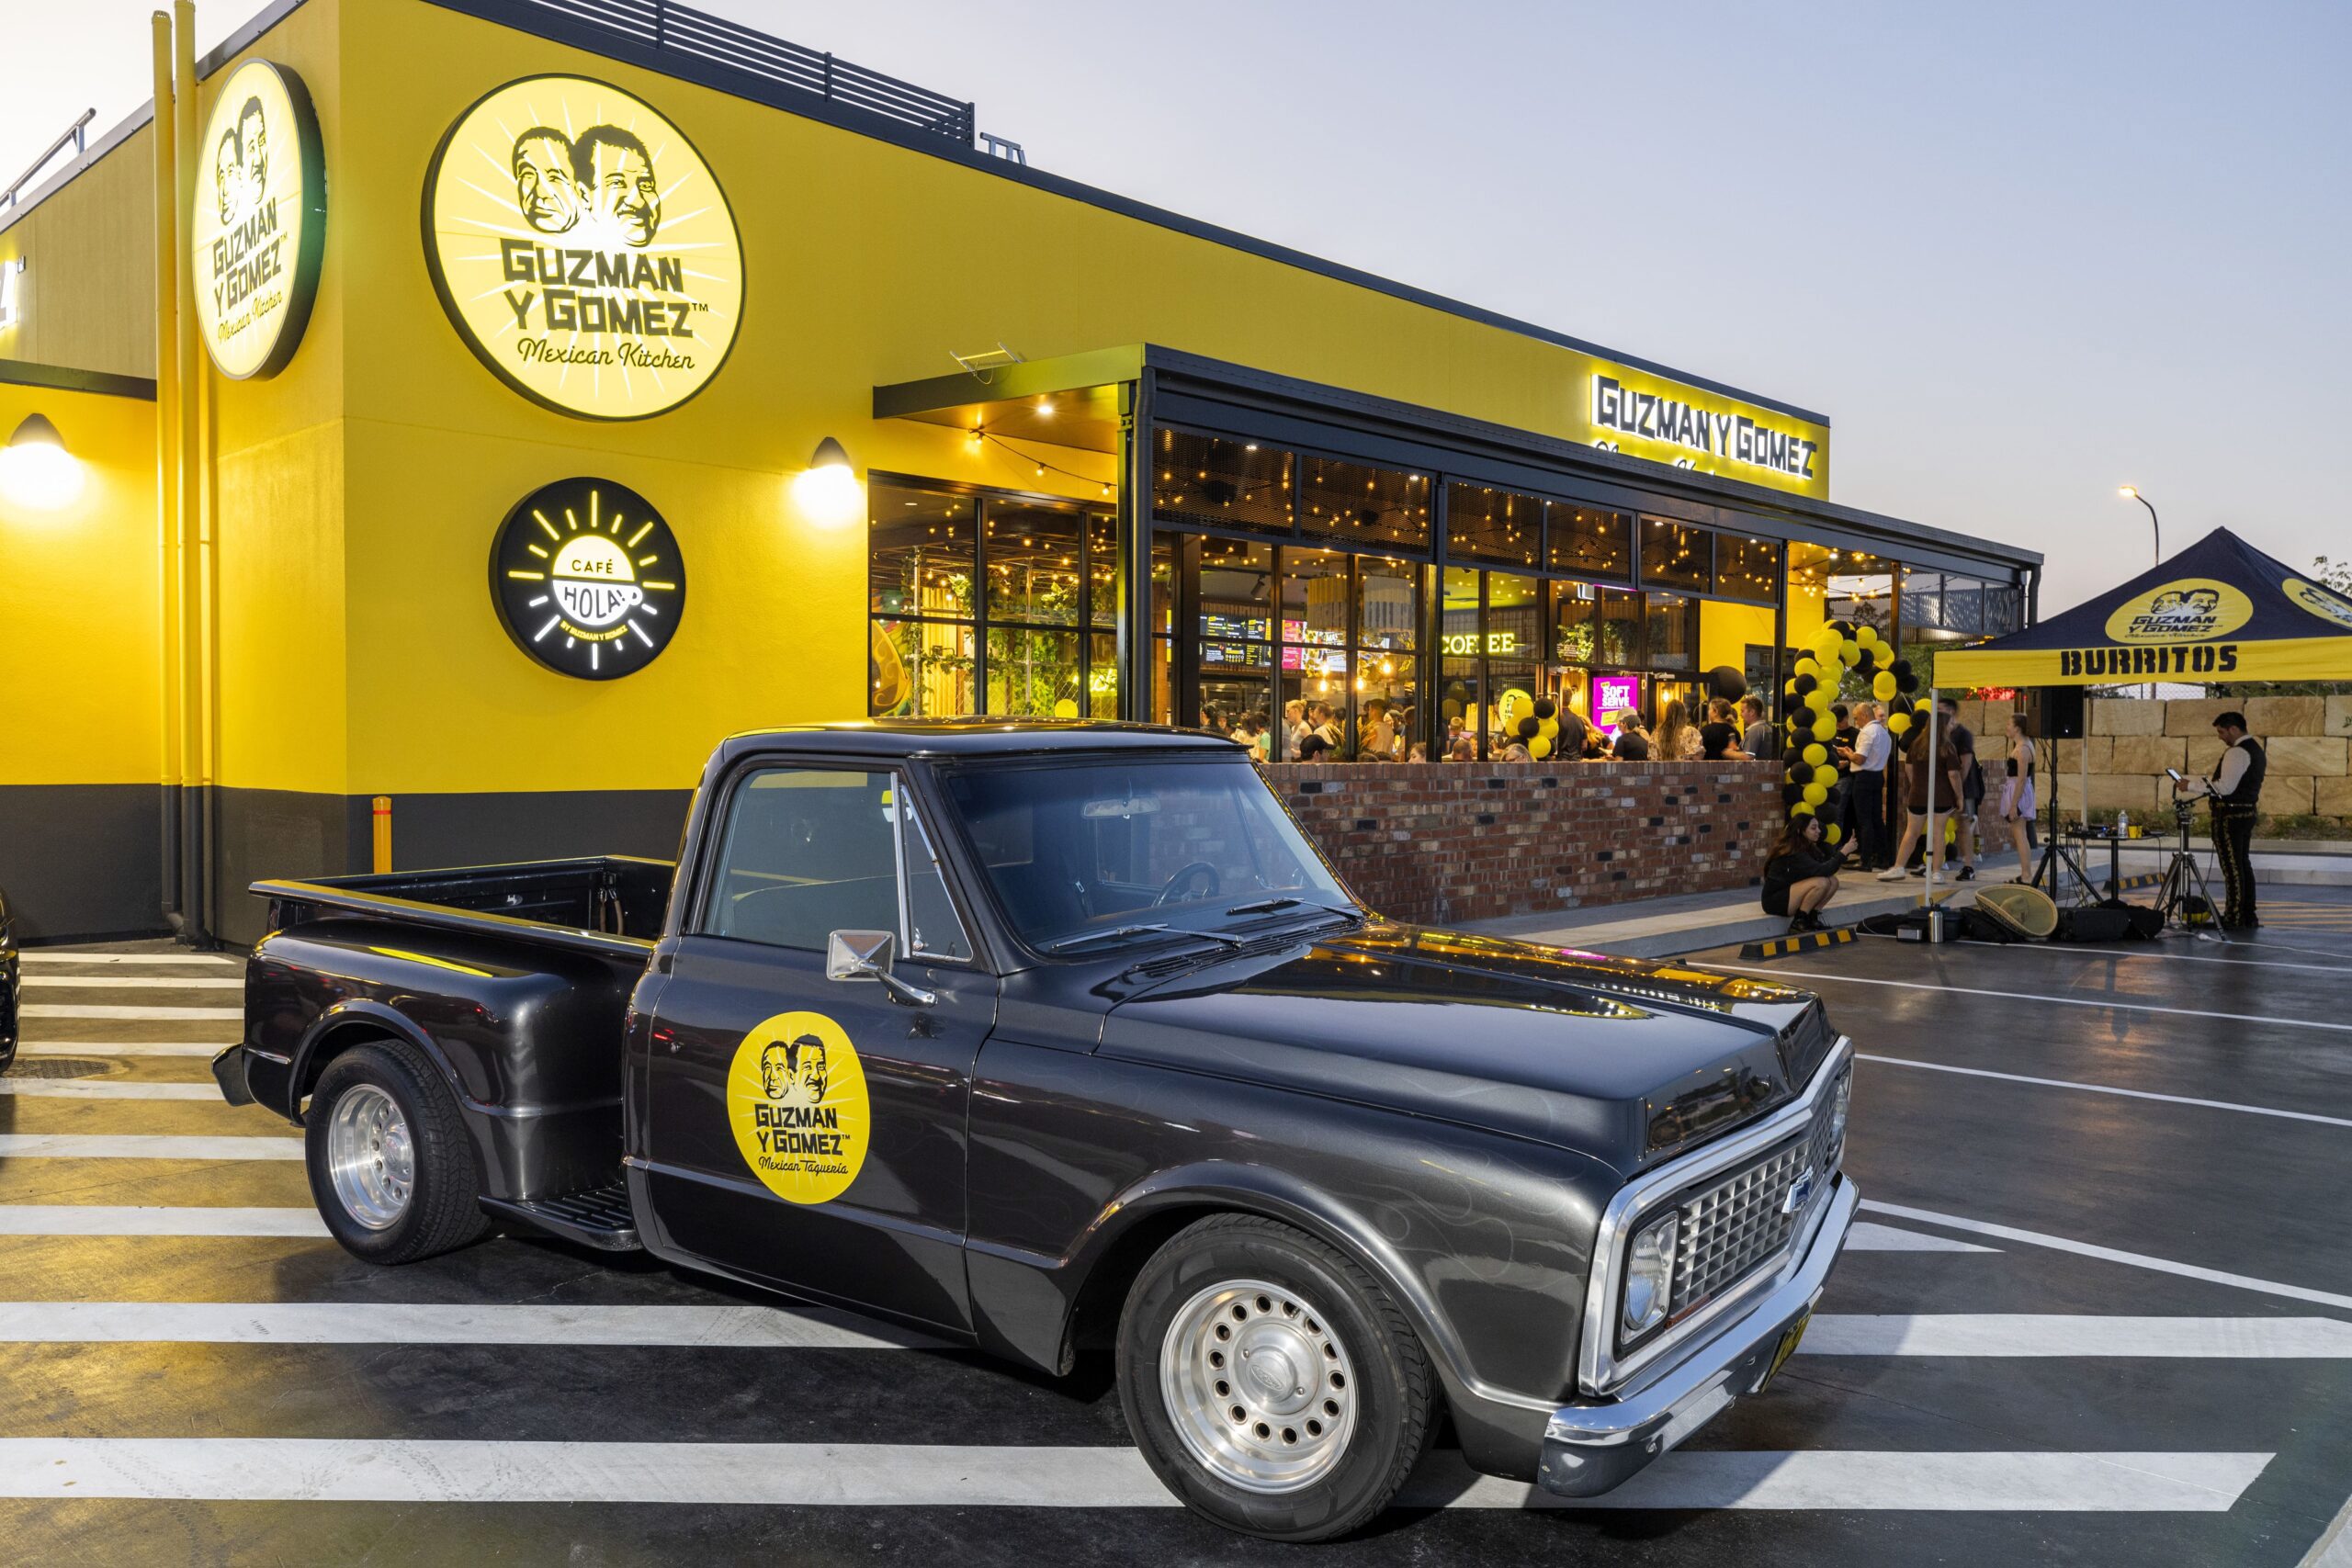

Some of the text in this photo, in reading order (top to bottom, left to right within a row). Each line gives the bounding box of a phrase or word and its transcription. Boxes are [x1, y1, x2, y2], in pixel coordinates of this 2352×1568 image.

[212, 197, 277, 279] GUZMAN
[500, 238, 684, 292] GUZMAN
[214, 283, 224, 318] Y
[503, 289, 535, 330] Y
[218, 291, 283, 344] Mexican Kitchen
[517, 337, 695, 369] Mexican Kitchen
[1591, 374, 1817, 479] GUZMAN Y GOMEZ
[571, 558, 614, 574] CAFÉ
[2128, 626, 2141, 634] Y
[2132, 615, 2217, 625] GUZMAN
[2061, 645, 2238, 676] BURRITOS
[1601, 685, 1631, 698] SOFT
[754, 1103, 839, 1130] GUZMAN
[756, 1131, 770, 1154] Y
[758, 1156, 801, 1172] Mexican
